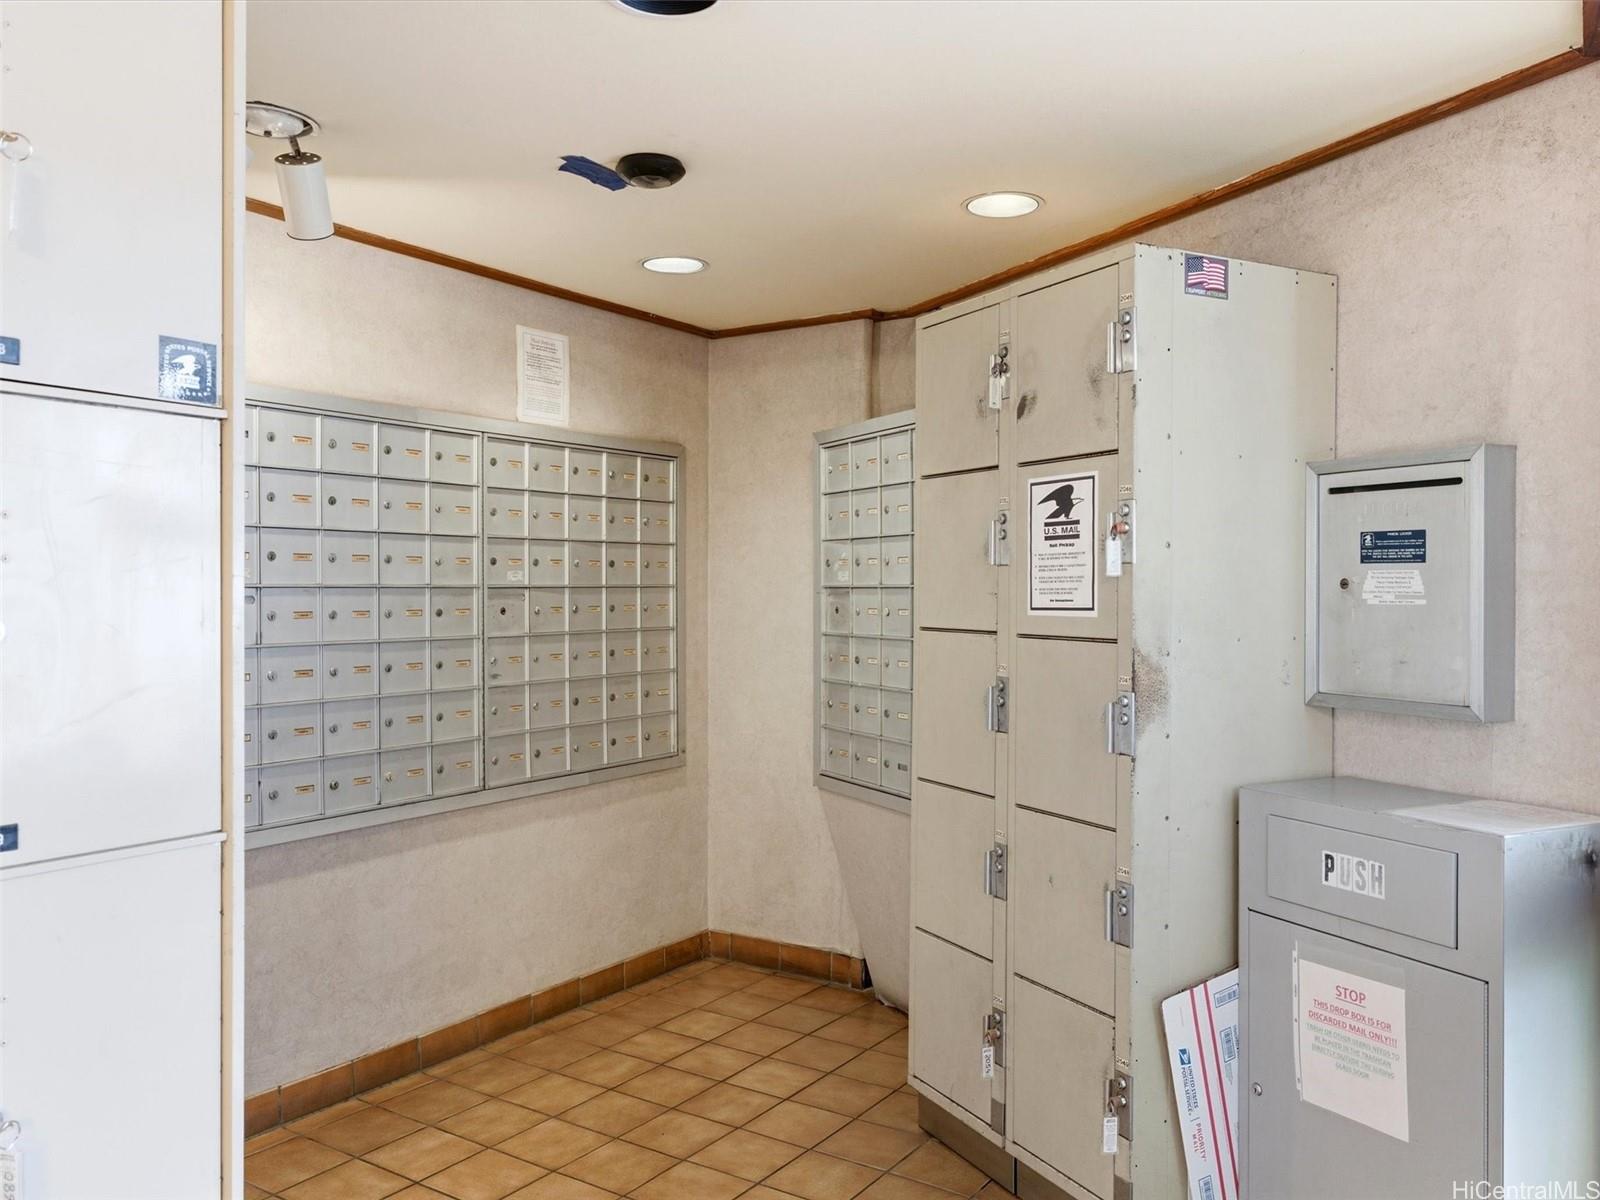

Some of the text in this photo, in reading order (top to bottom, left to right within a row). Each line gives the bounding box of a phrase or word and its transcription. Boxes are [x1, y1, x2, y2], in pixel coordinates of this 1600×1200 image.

[1043, 525, 1081, 535] U.S. MAIL
[1324, 853, 1384, 896] PUSH
[1335, 984, 1367, 1004] STOP
[1308, 1010, 1398, 1049] DISCARDED MAIL ONLY!!!
[1313, 998, 1392, 1031] THIS DROP BOX IS FOR
[1181, 1067, 1190, 1089] POSTAL
[1187, 1066, 1200, 1109] UNITED STATES
[1195, 1122, 1206, 1159] PRIORITY
